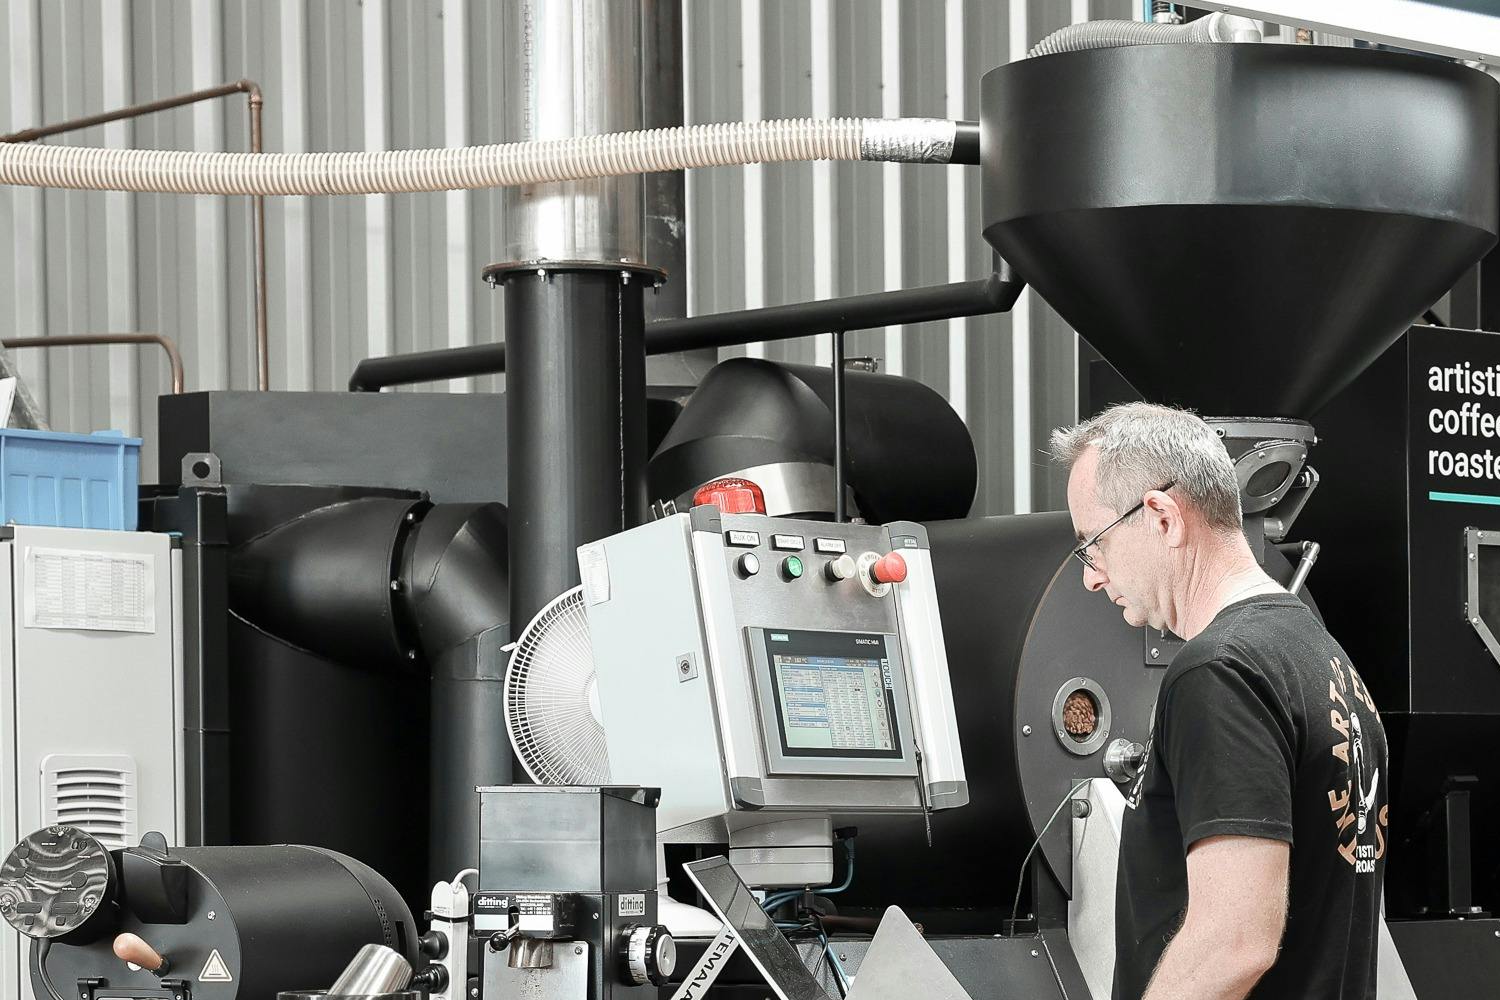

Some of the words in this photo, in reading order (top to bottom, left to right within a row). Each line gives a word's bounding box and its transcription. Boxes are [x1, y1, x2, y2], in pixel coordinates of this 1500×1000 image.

[733, 534, 745, 542] AUX
[746, 534, 756, 542] ON
[882, 659, 893, 690] TOUCH
[1329, 680, 1352, 766] ART
[477, 896, 509, 909] ditting
[620, 896, 644, 913] ditting
